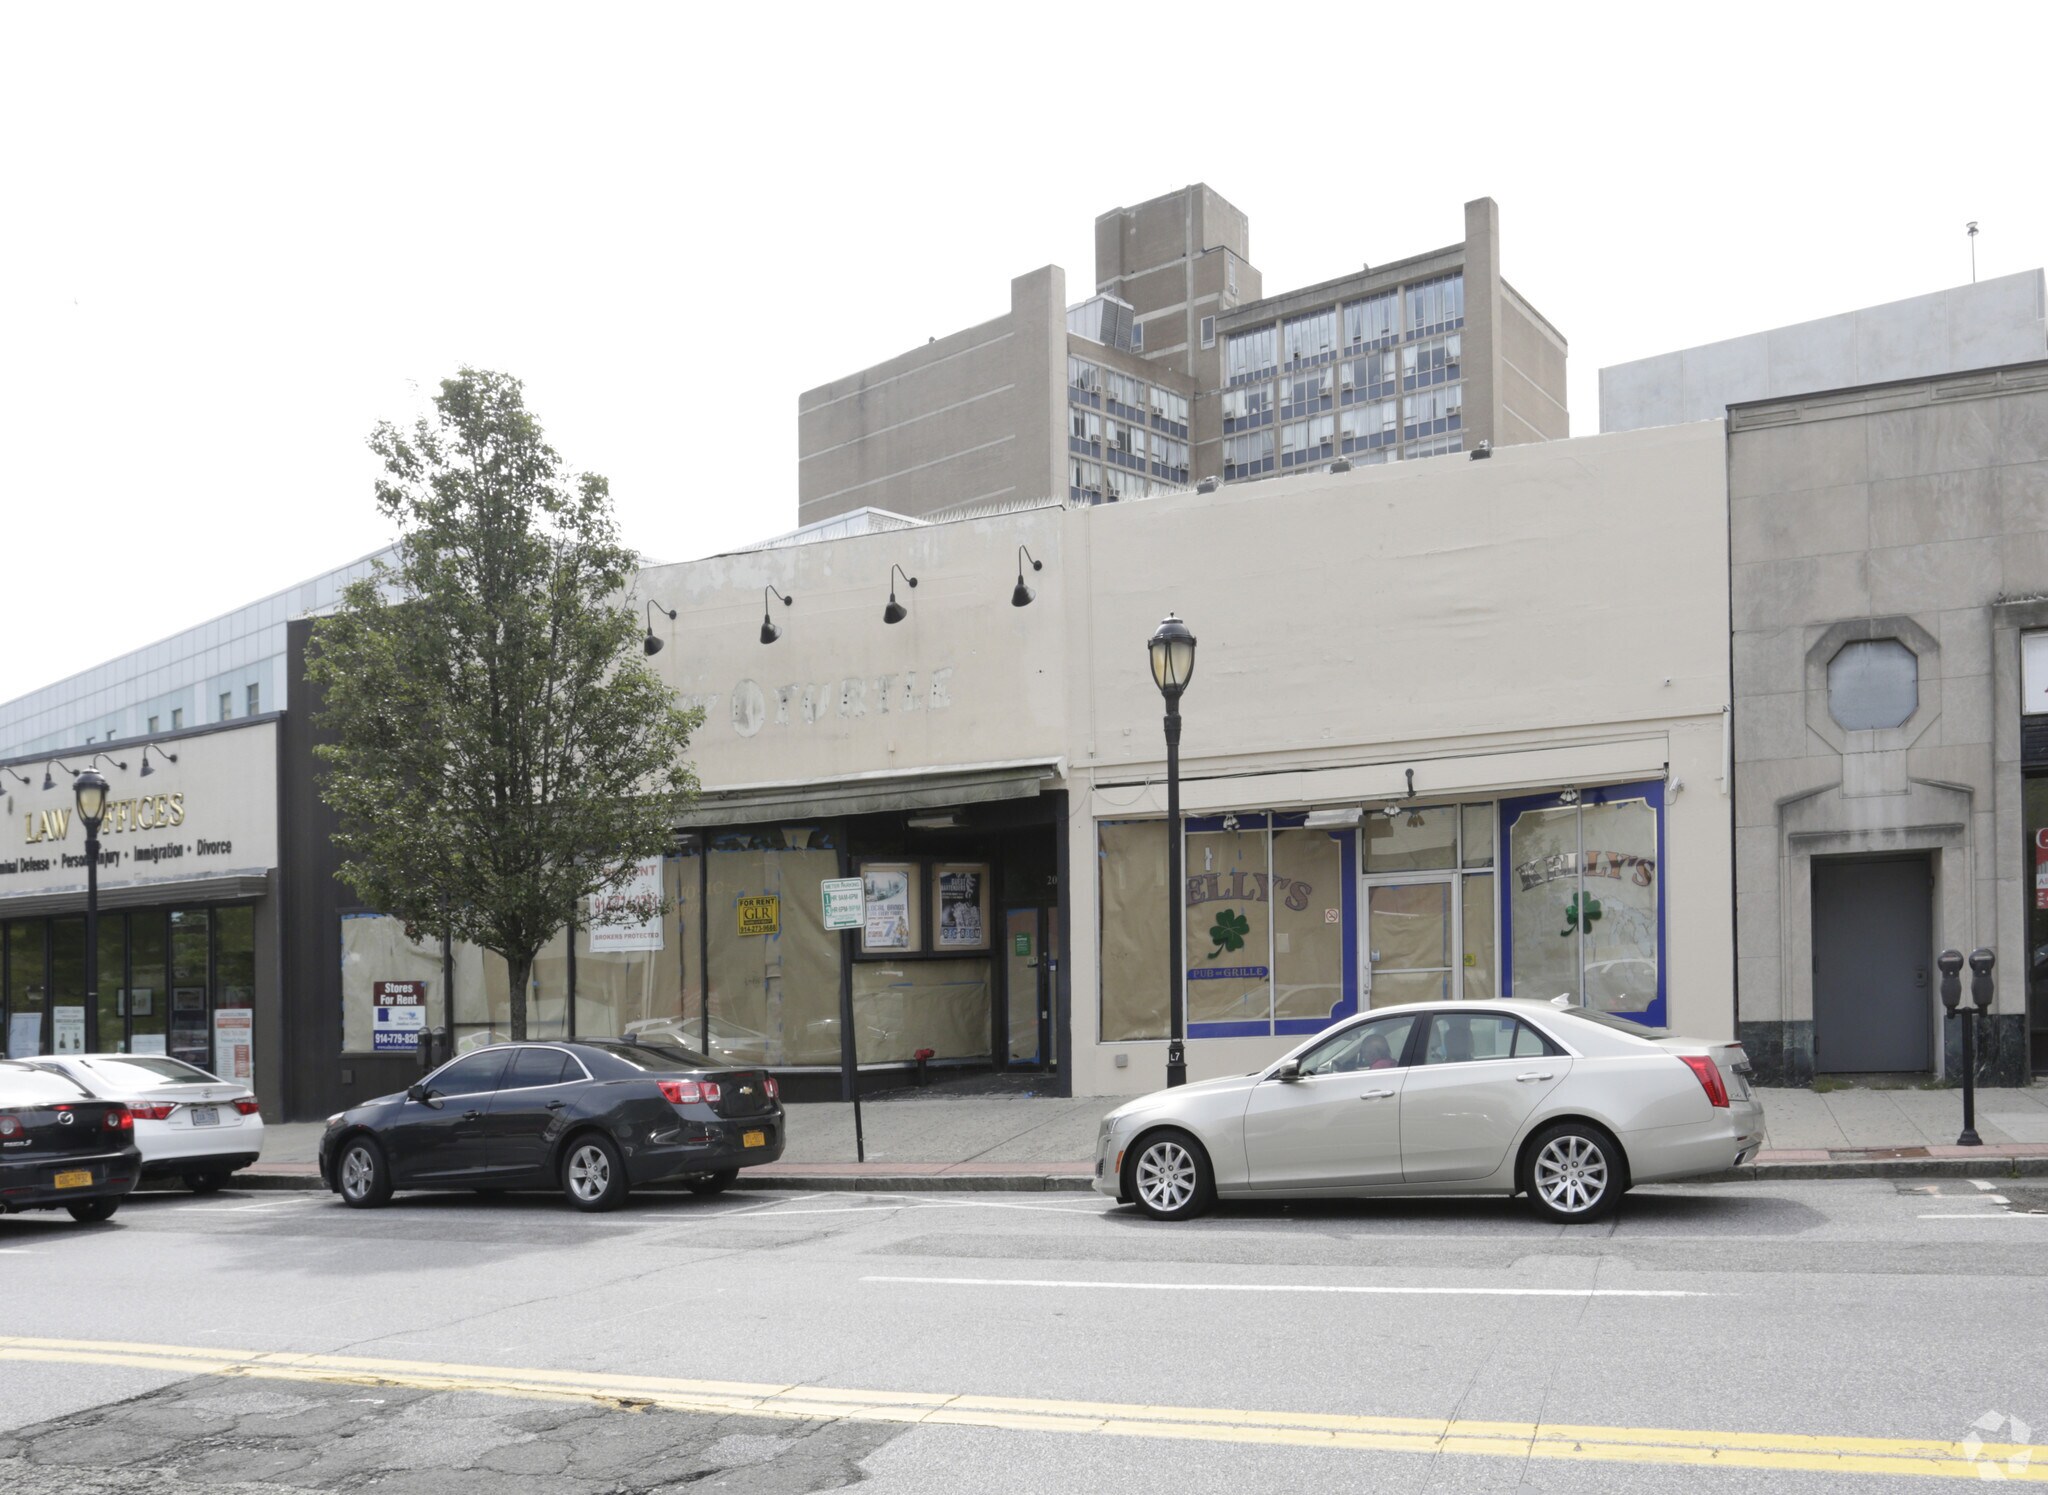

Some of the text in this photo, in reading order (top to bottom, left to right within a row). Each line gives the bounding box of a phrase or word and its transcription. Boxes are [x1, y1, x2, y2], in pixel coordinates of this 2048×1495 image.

[25, 792, 185, 844] LAW FFICES
[20, 857, 50, 874] Defense
[134, 843, 184, 864] Immigration
[197, 839, 232, 857] Divorce
[1515, 850, 1655, 892] KELLY'S
[1186, 872, 1313, 912] ELLY'S
[744, 907, 770, 920] GLR
[595, 931, 660, 941] BROKERS PROTECTED
[1193, 969, 1214, 978] PUB
[1223, 967, 1264, 976] GRILLE
[385, 983, 413, 993] Stores
[380, 994, 417, 1005] For Rent
[375, 1034, 418, 1044] 914-779-820
[1170, 1052, 1180, 1061] L7
